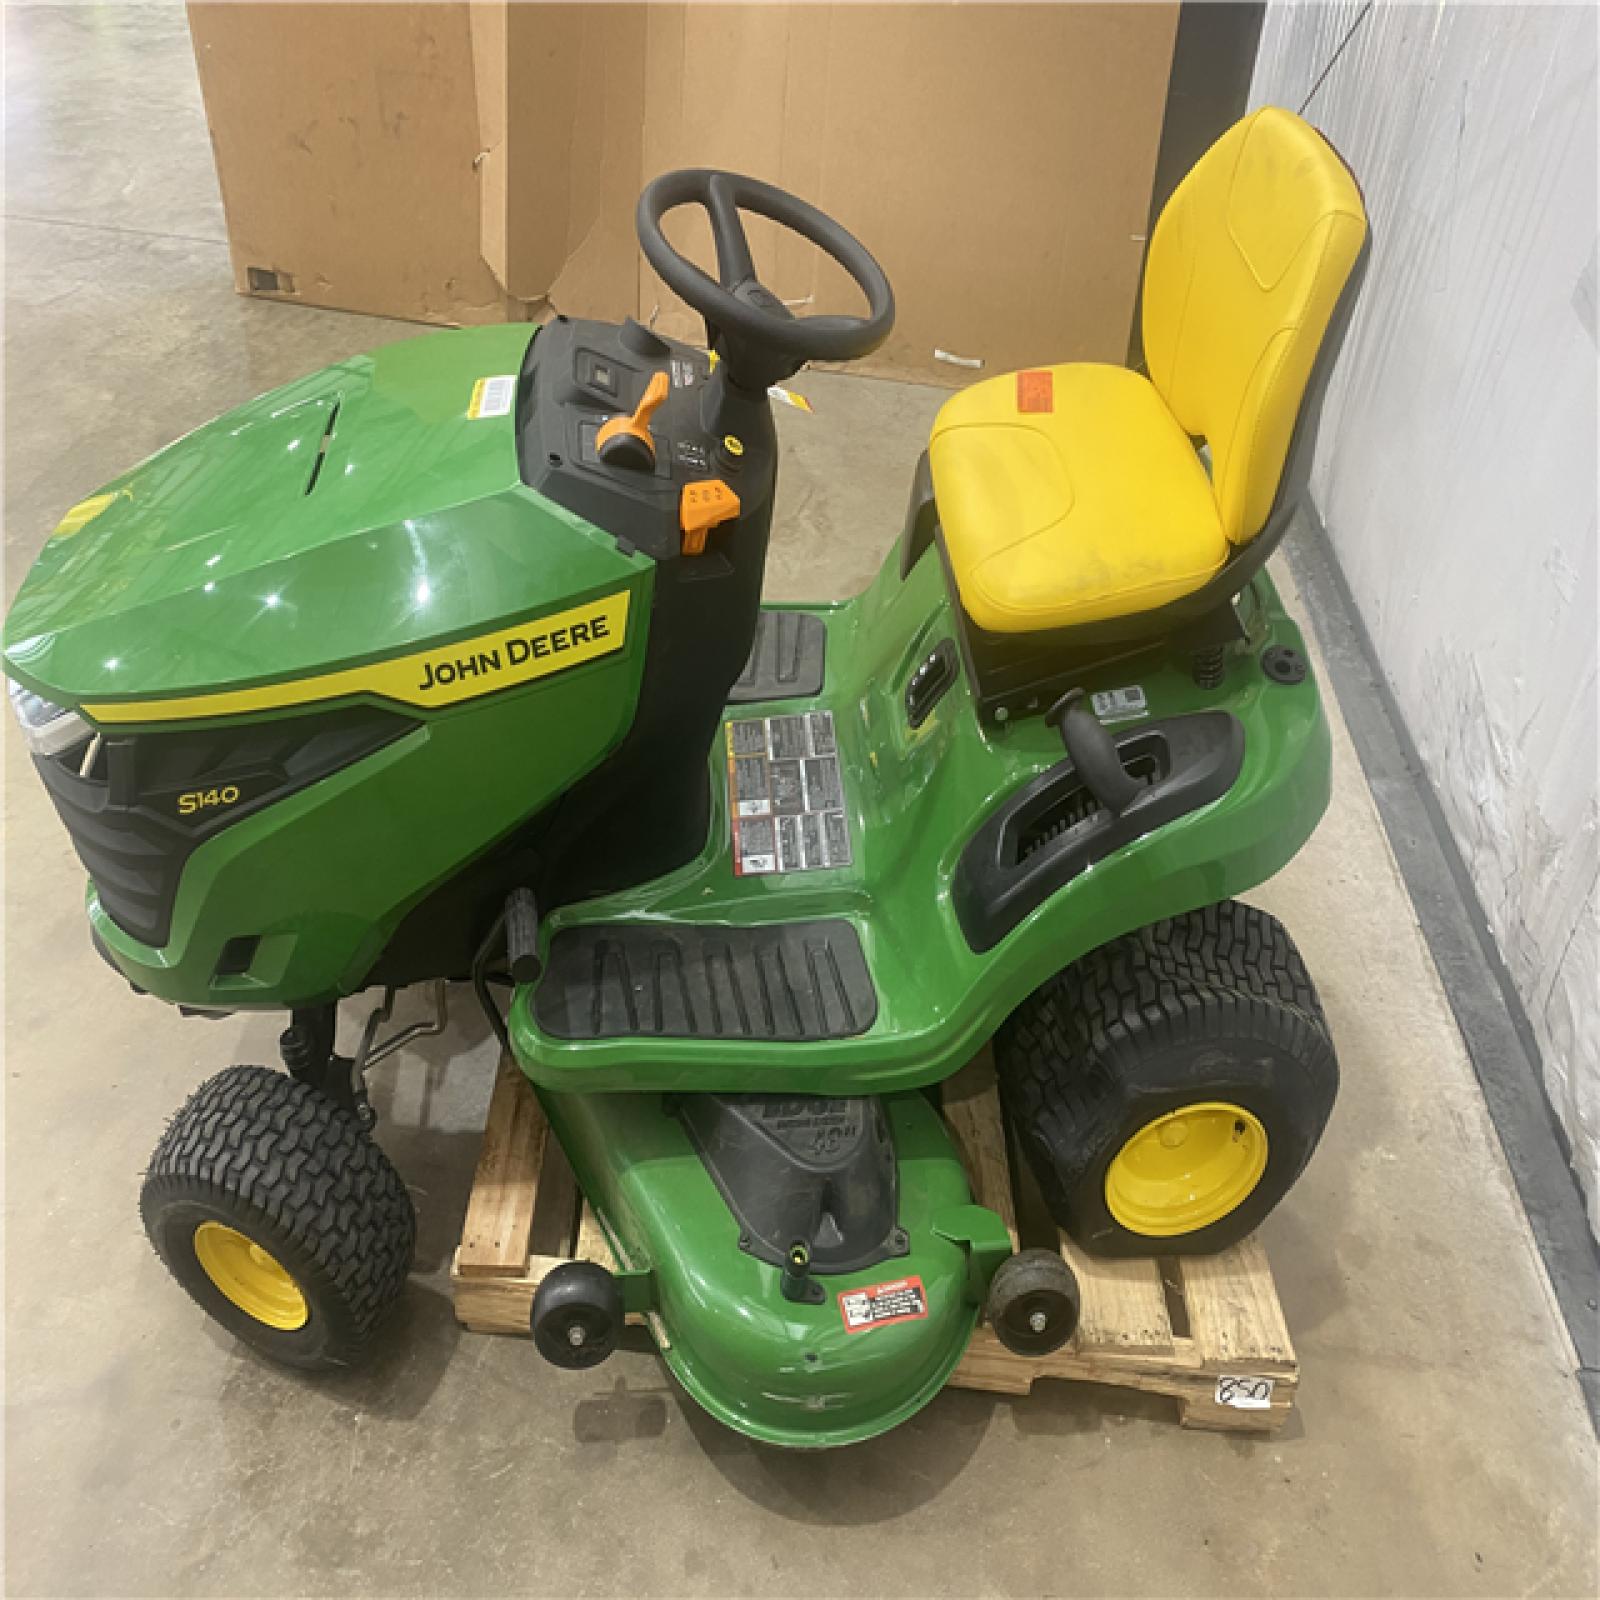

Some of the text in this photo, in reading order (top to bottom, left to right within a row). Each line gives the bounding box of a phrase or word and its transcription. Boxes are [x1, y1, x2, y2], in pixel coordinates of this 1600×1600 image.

[418, 614, 610, 690] JOHN DEERE
[178, 785, 239, 815] S140
